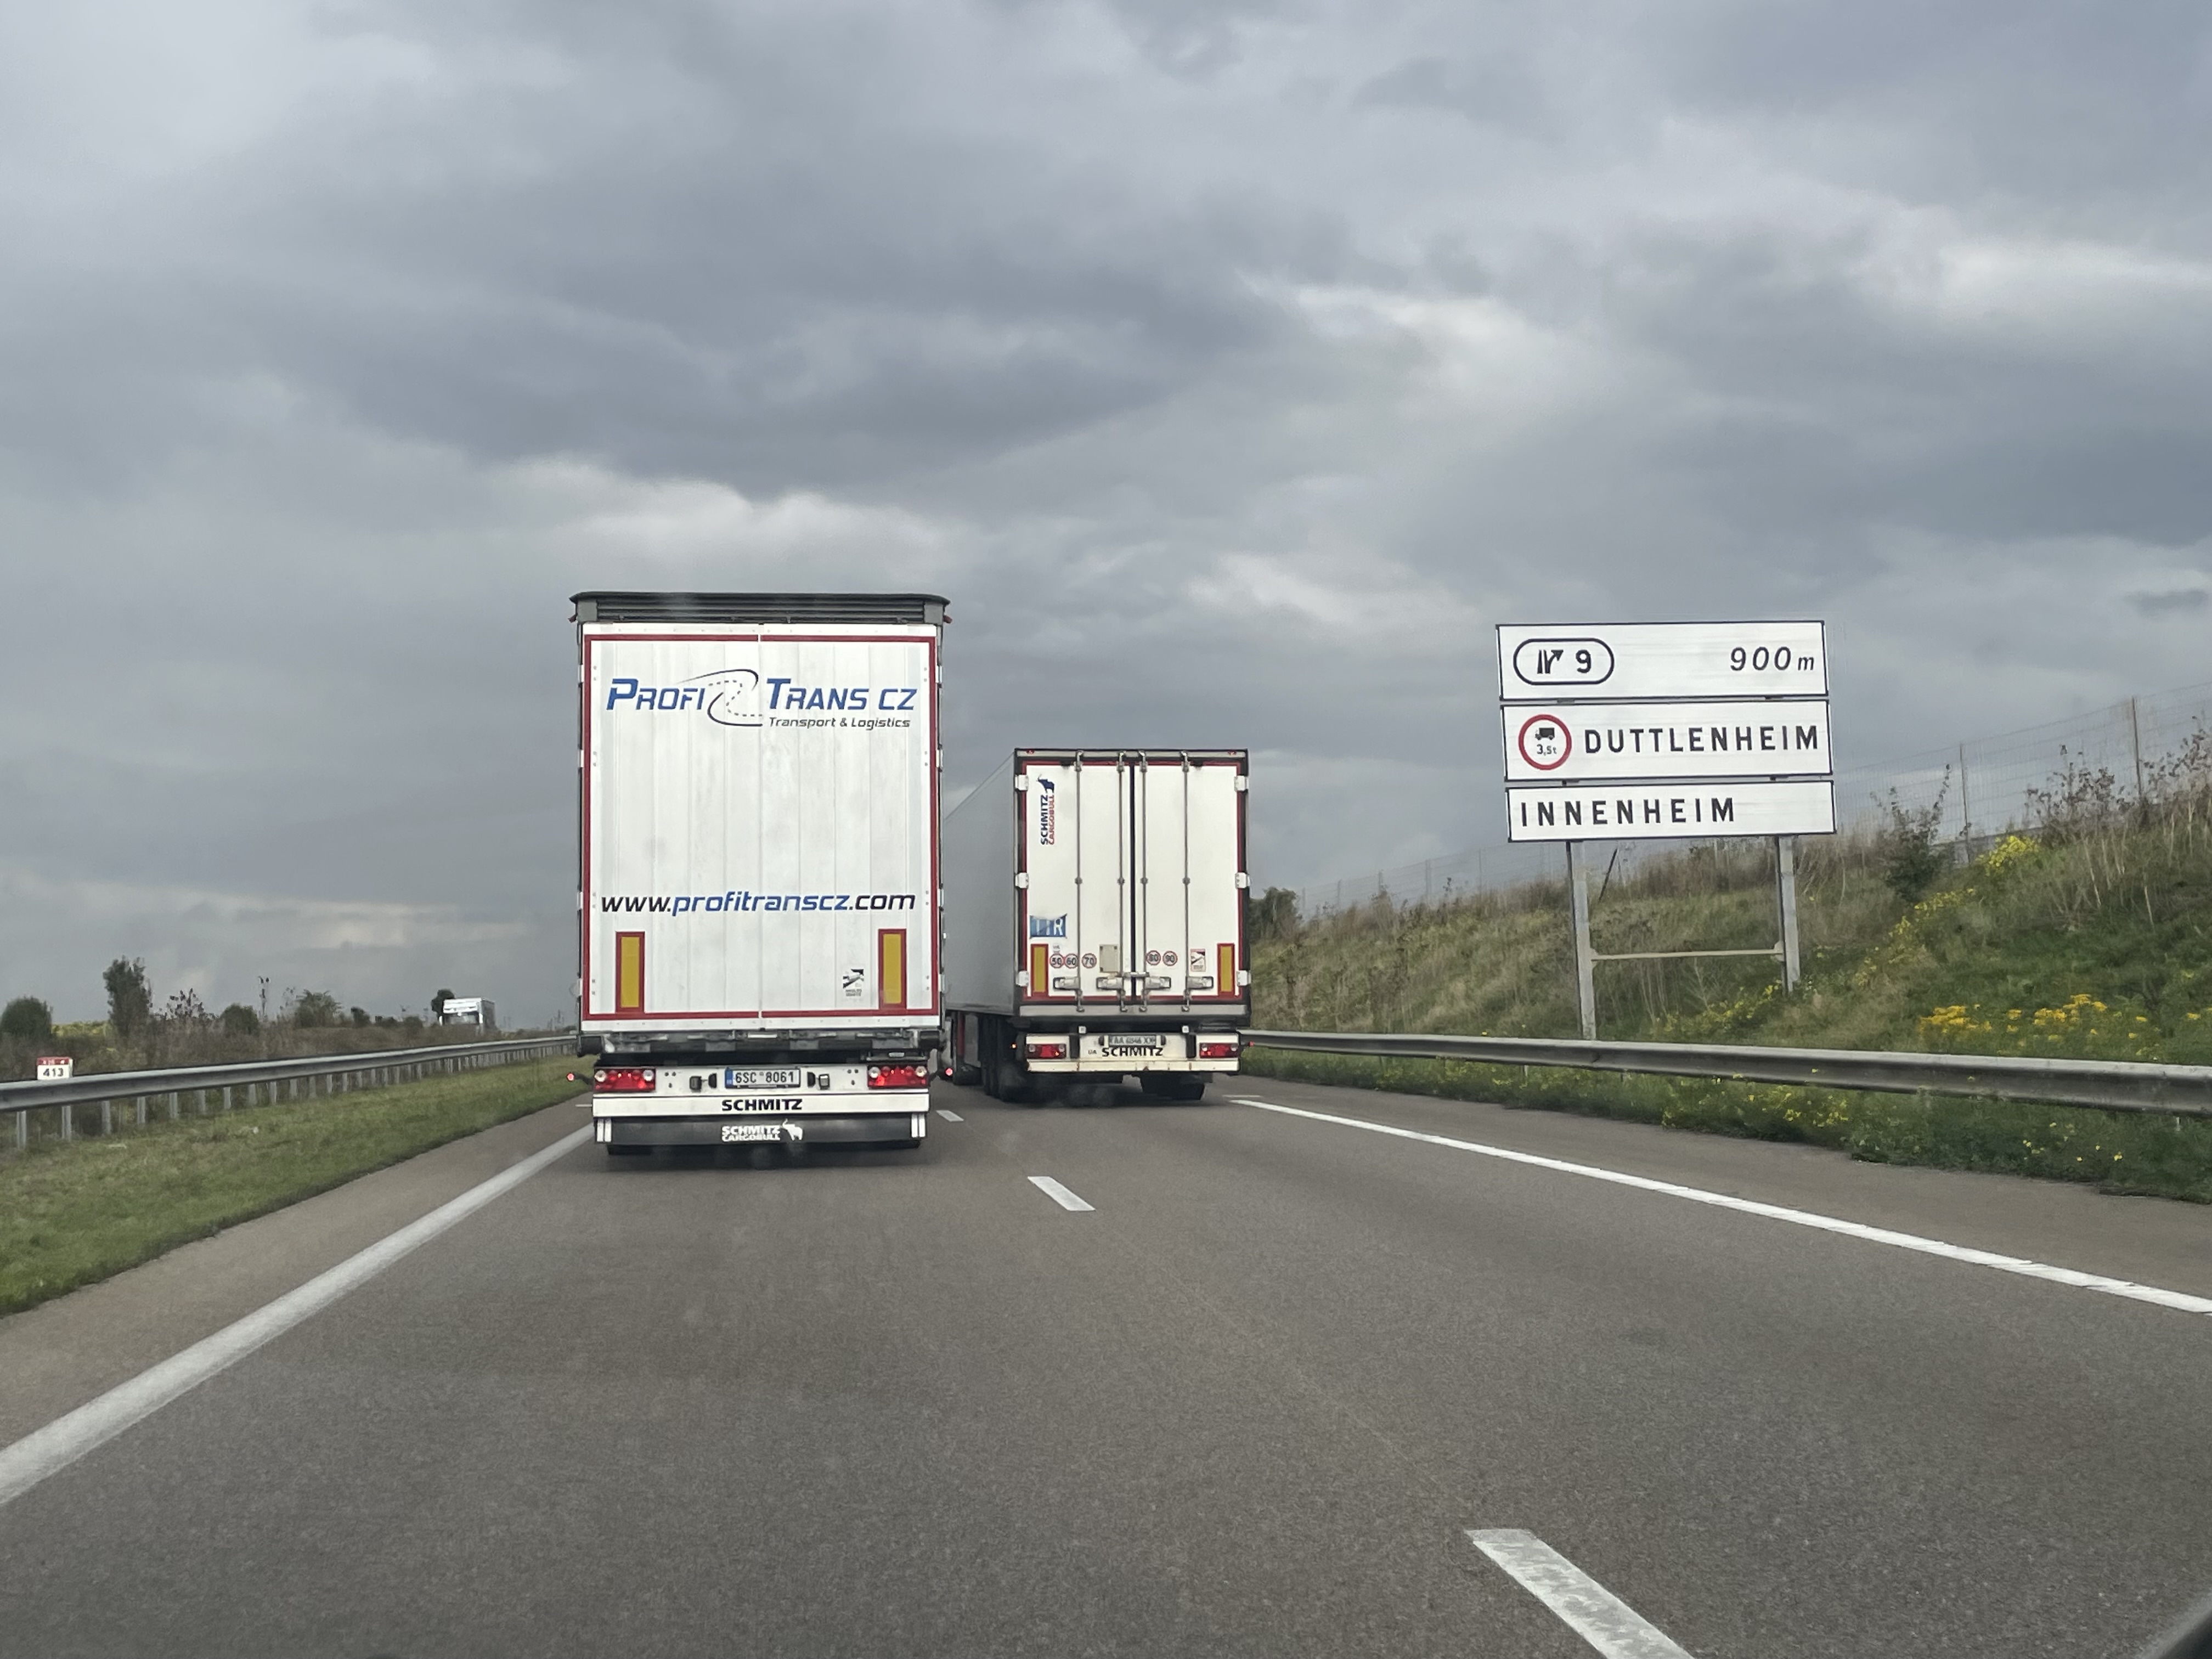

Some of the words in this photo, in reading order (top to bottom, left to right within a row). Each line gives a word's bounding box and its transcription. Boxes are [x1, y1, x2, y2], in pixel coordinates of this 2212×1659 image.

[1576, 650, 1592, 674] 9
[878, 688, 918, 710] CZ
[769, 717, 836, 729] Transport
[840, 717, 848, 727] &
[851, 717, 911, 731] Logistics
[1585, 725, 1819, 754] DUTTLENHEIM
[1521, 797, 1735, 827] INNENHEIM
[1040, 794, 1048, 845] SCHMITZ
[601, 891, 916, 917] www.profitranscz.com
[1052, 957, 1062, 966] 50
[1066, 957, 1076, 966] 60
[1084, 957, 1094, 966] 70
[1165, 954, 1175, 963] 90
[1102, 1047, 1164, 1057] SCHMITZ
[43, 1068, 64, 1077] 413
[735, 1071, 757, 1084] 6SC
[765, 1071, 794, 1083] 8061
[721, 1098, 803, 1111] SCHMITZ
[722, 1125, 780, 1135] SCHMITZ
